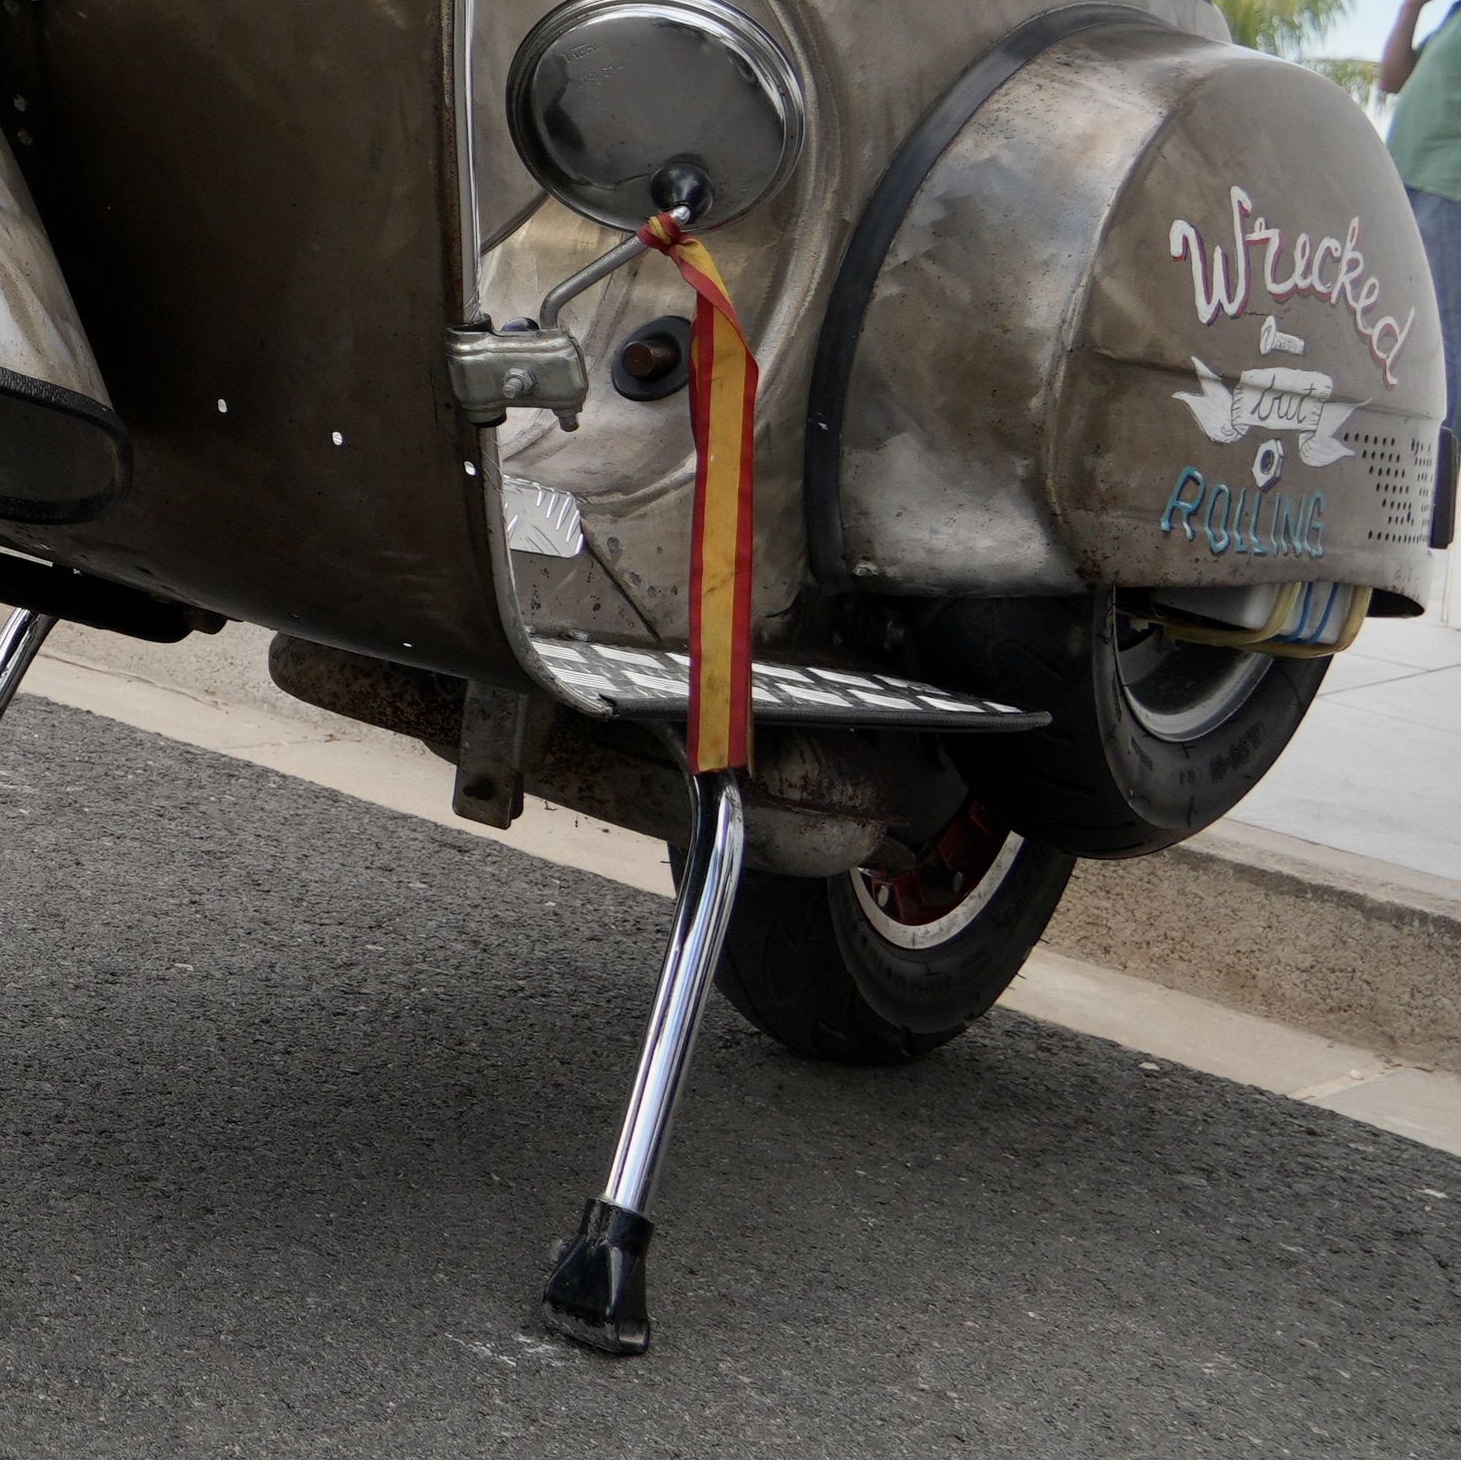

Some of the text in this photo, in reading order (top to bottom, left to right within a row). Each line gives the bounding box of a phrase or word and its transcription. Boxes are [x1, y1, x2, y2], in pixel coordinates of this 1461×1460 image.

[1169, 185, 1416, 388] Wrecked
[1250, 374, 1317, 425] but
[1160, 466, 1328, 559] ROLLING
